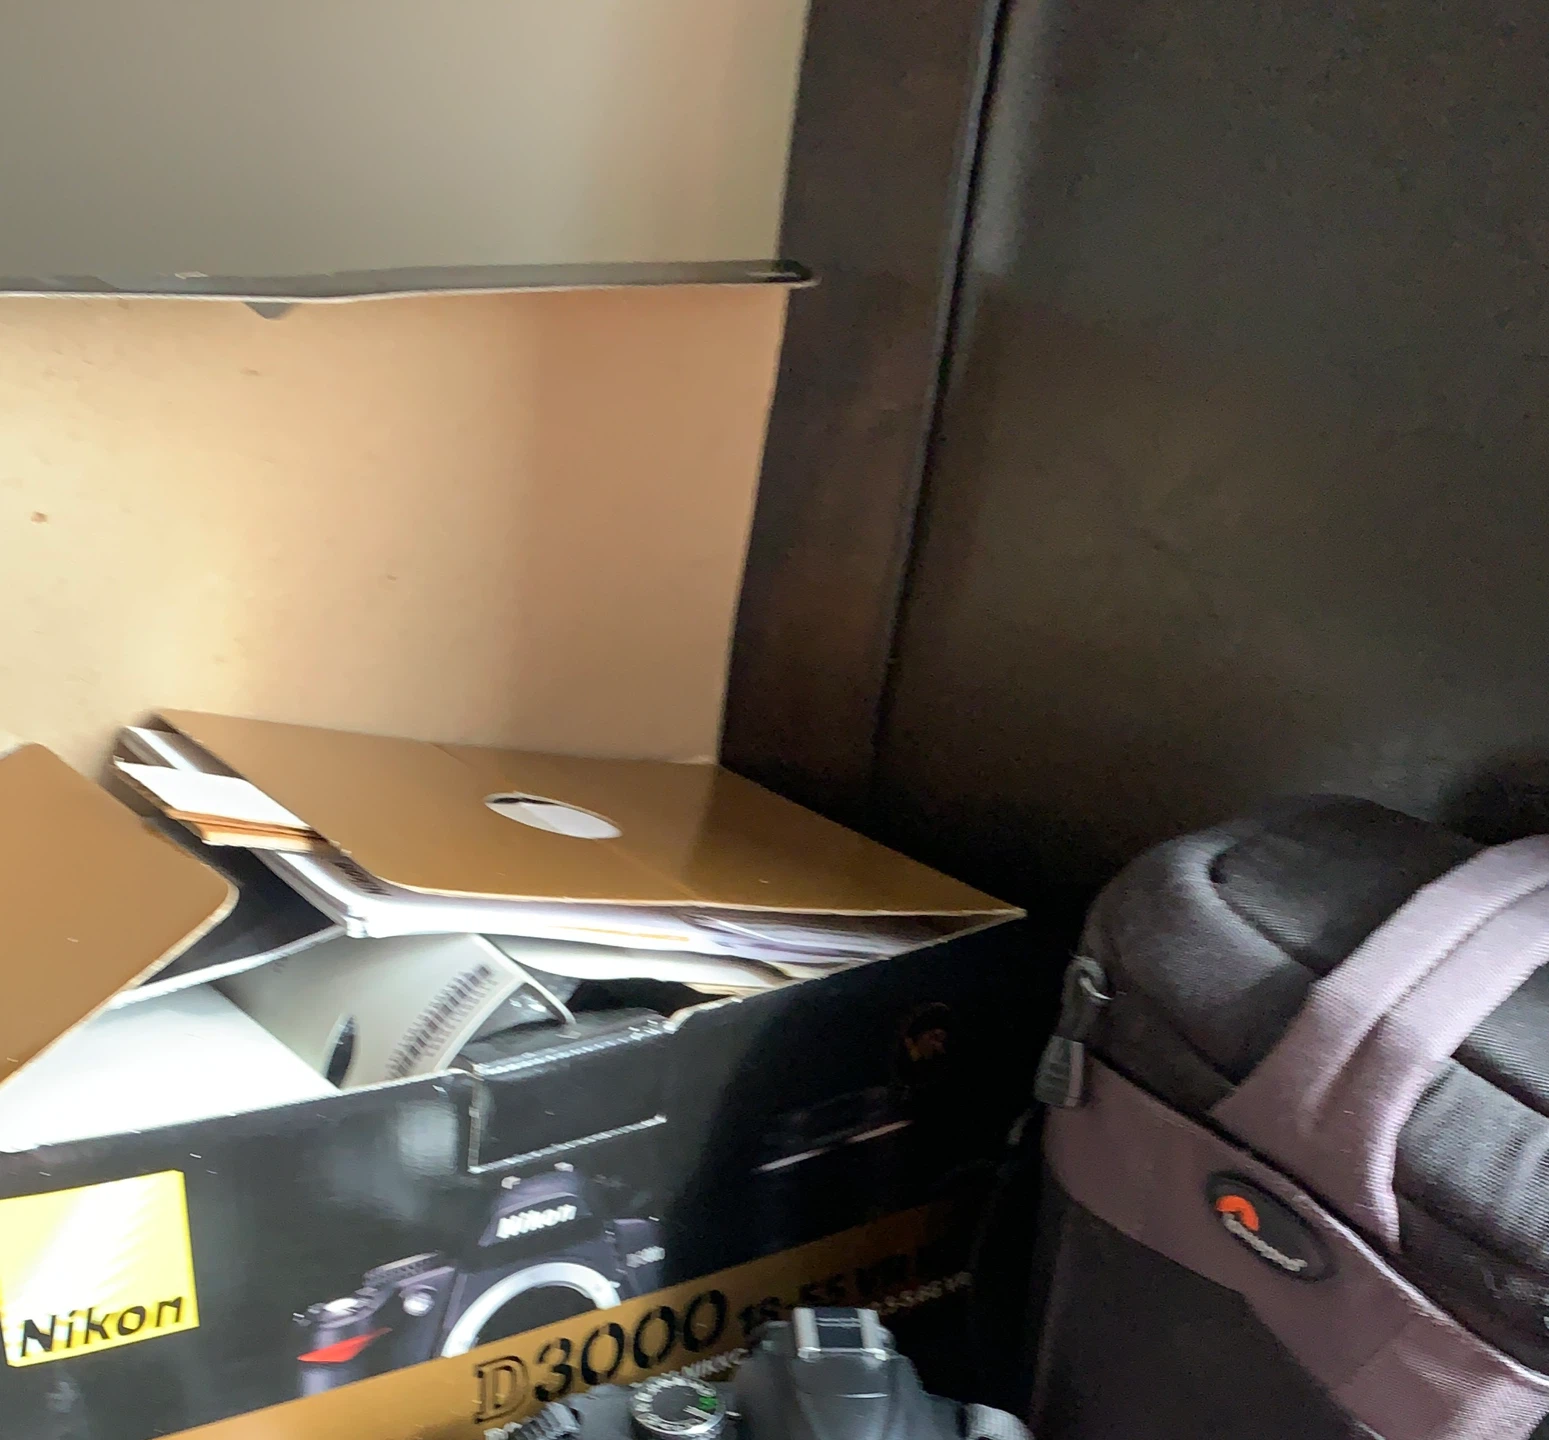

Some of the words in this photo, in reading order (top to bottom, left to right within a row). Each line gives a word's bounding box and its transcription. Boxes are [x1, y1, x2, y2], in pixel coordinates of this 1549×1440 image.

[496, 1203, 577, 1239] Nikon
[20, 1296, 183, 1358] Nikon
[474, 1289, 728, 1424] D3000
